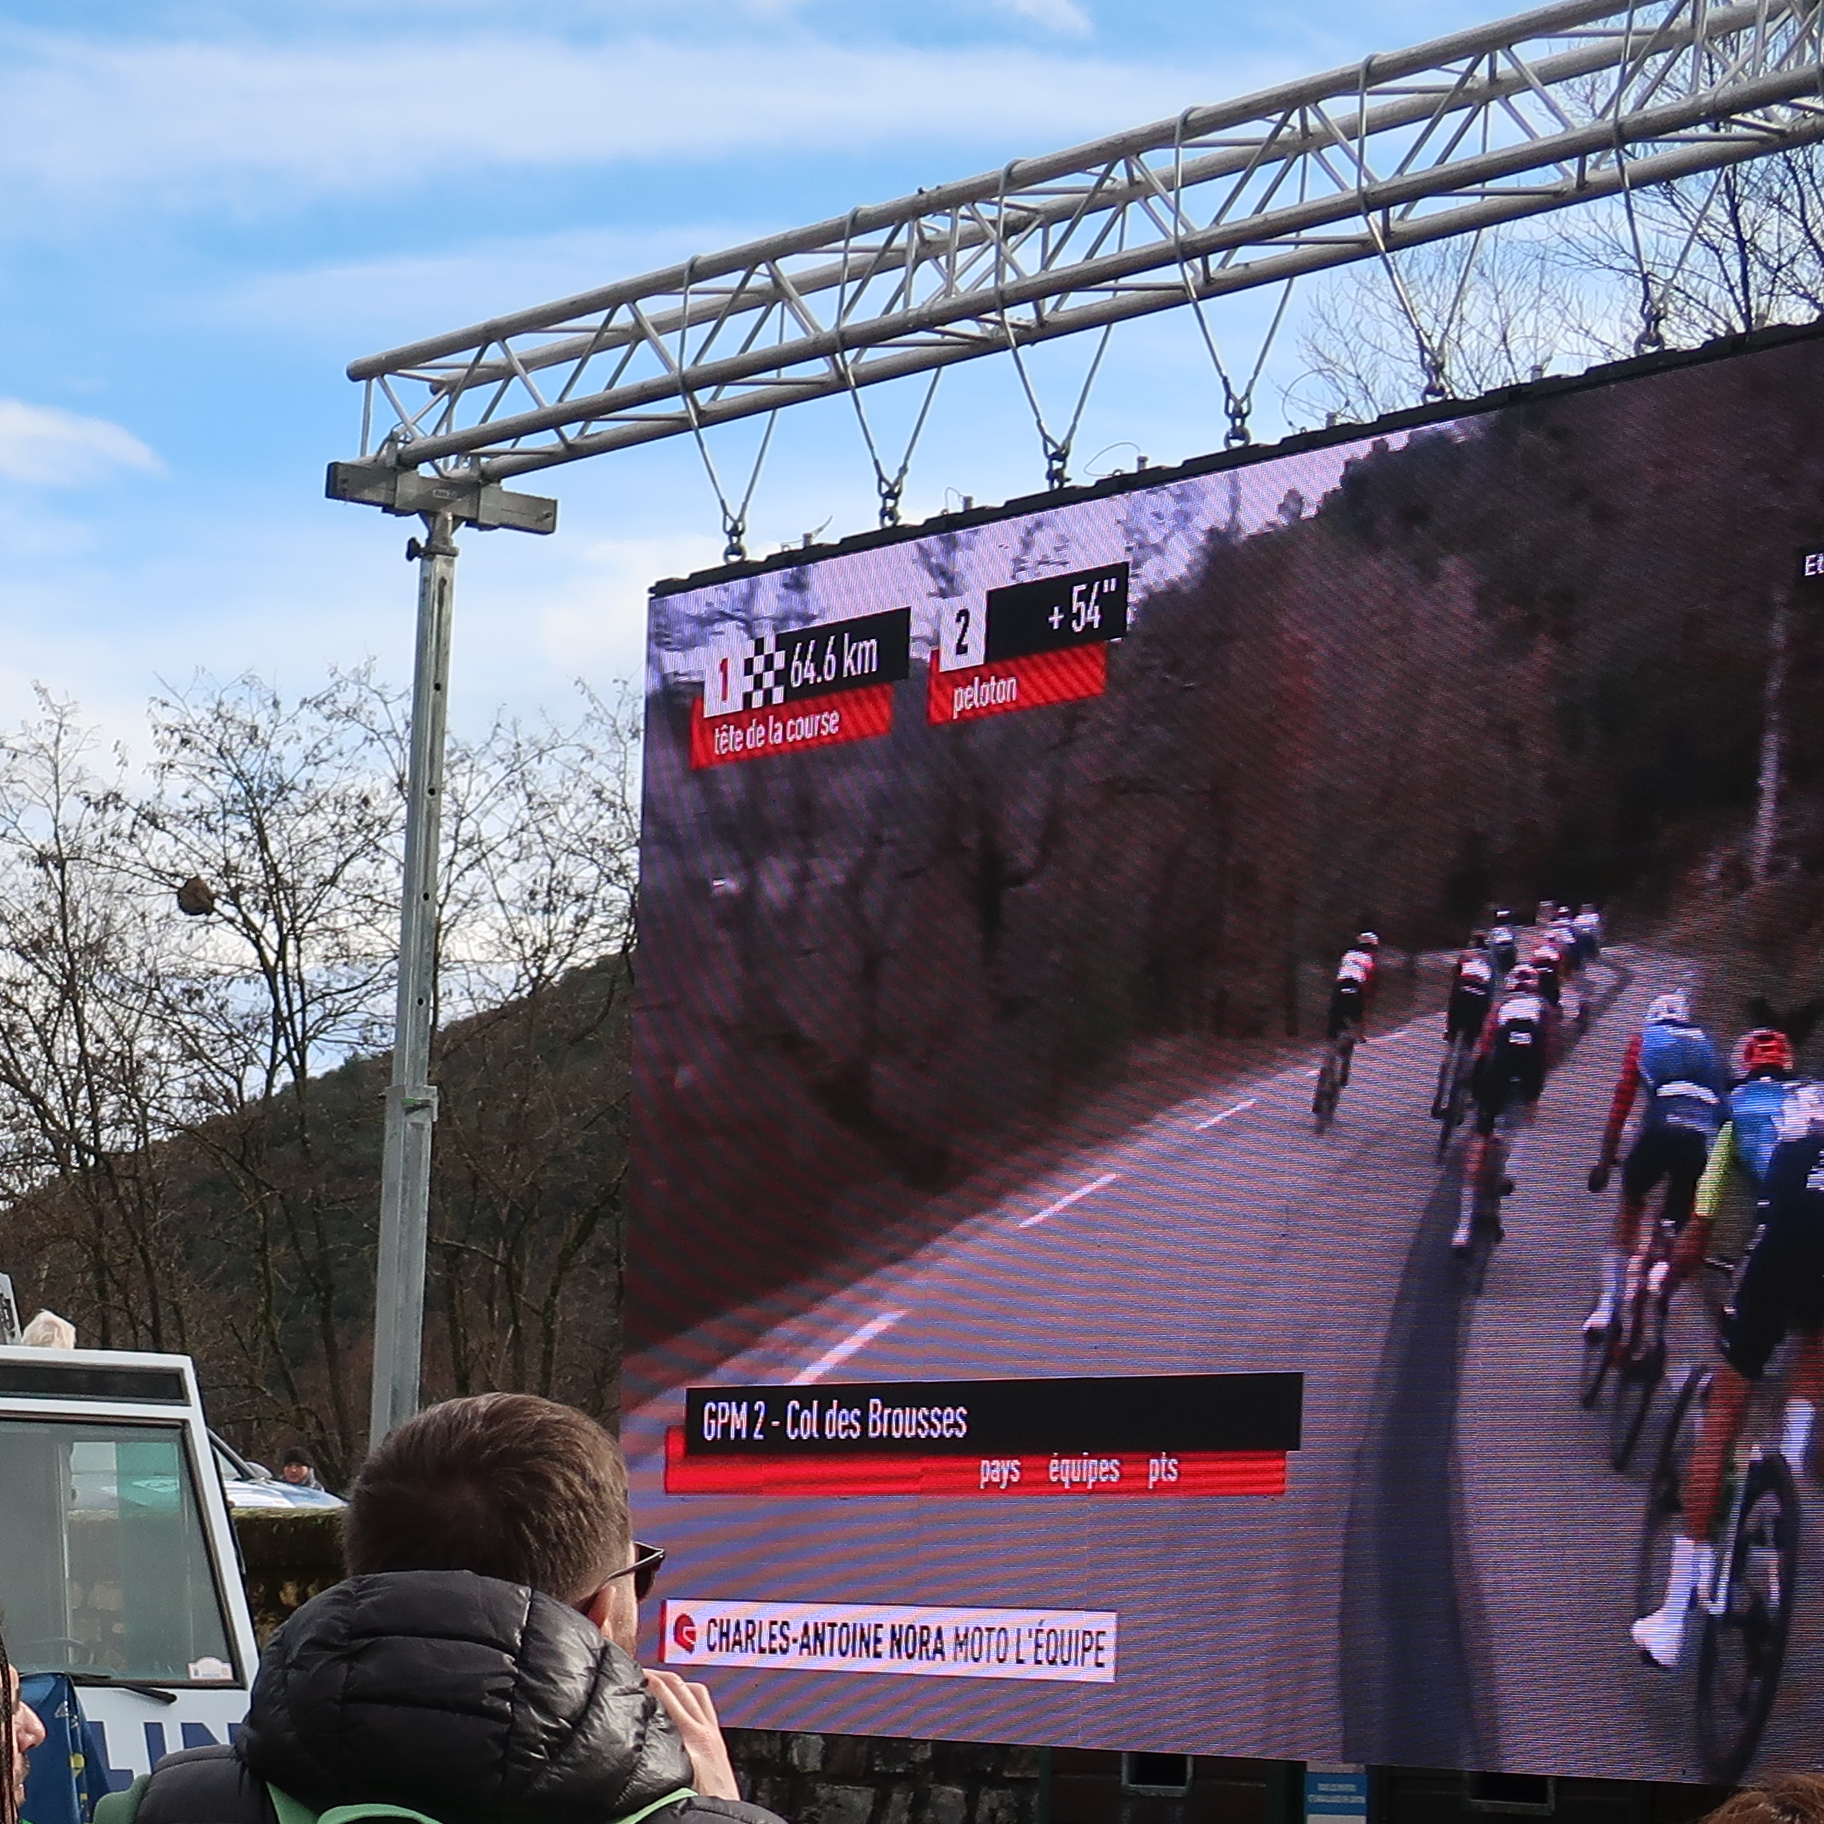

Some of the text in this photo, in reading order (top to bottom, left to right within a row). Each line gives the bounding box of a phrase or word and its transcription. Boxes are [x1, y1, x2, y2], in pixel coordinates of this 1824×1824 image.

[954, 607, 971, 656] 2
[719, 635, 879, 703] 1 64.6 km
[952, 675, 1017, 719] peloton
[713, 709, 840, 756] tête de la course
[702, 1400, 749, 1442] GPM
[752, 1400, 765, 1441] 2
[786, 1398, 820, 1440] Col
[824, 1398, 862, 1440] des
[867, 1398, 968, 1440] Brousses
[979, 1451, 1179, 1490] pays équipes pts
[706, 1617, 1107, 1668] CHARLES-ANTOINE NORA MOTO L'ÉQUIPE
